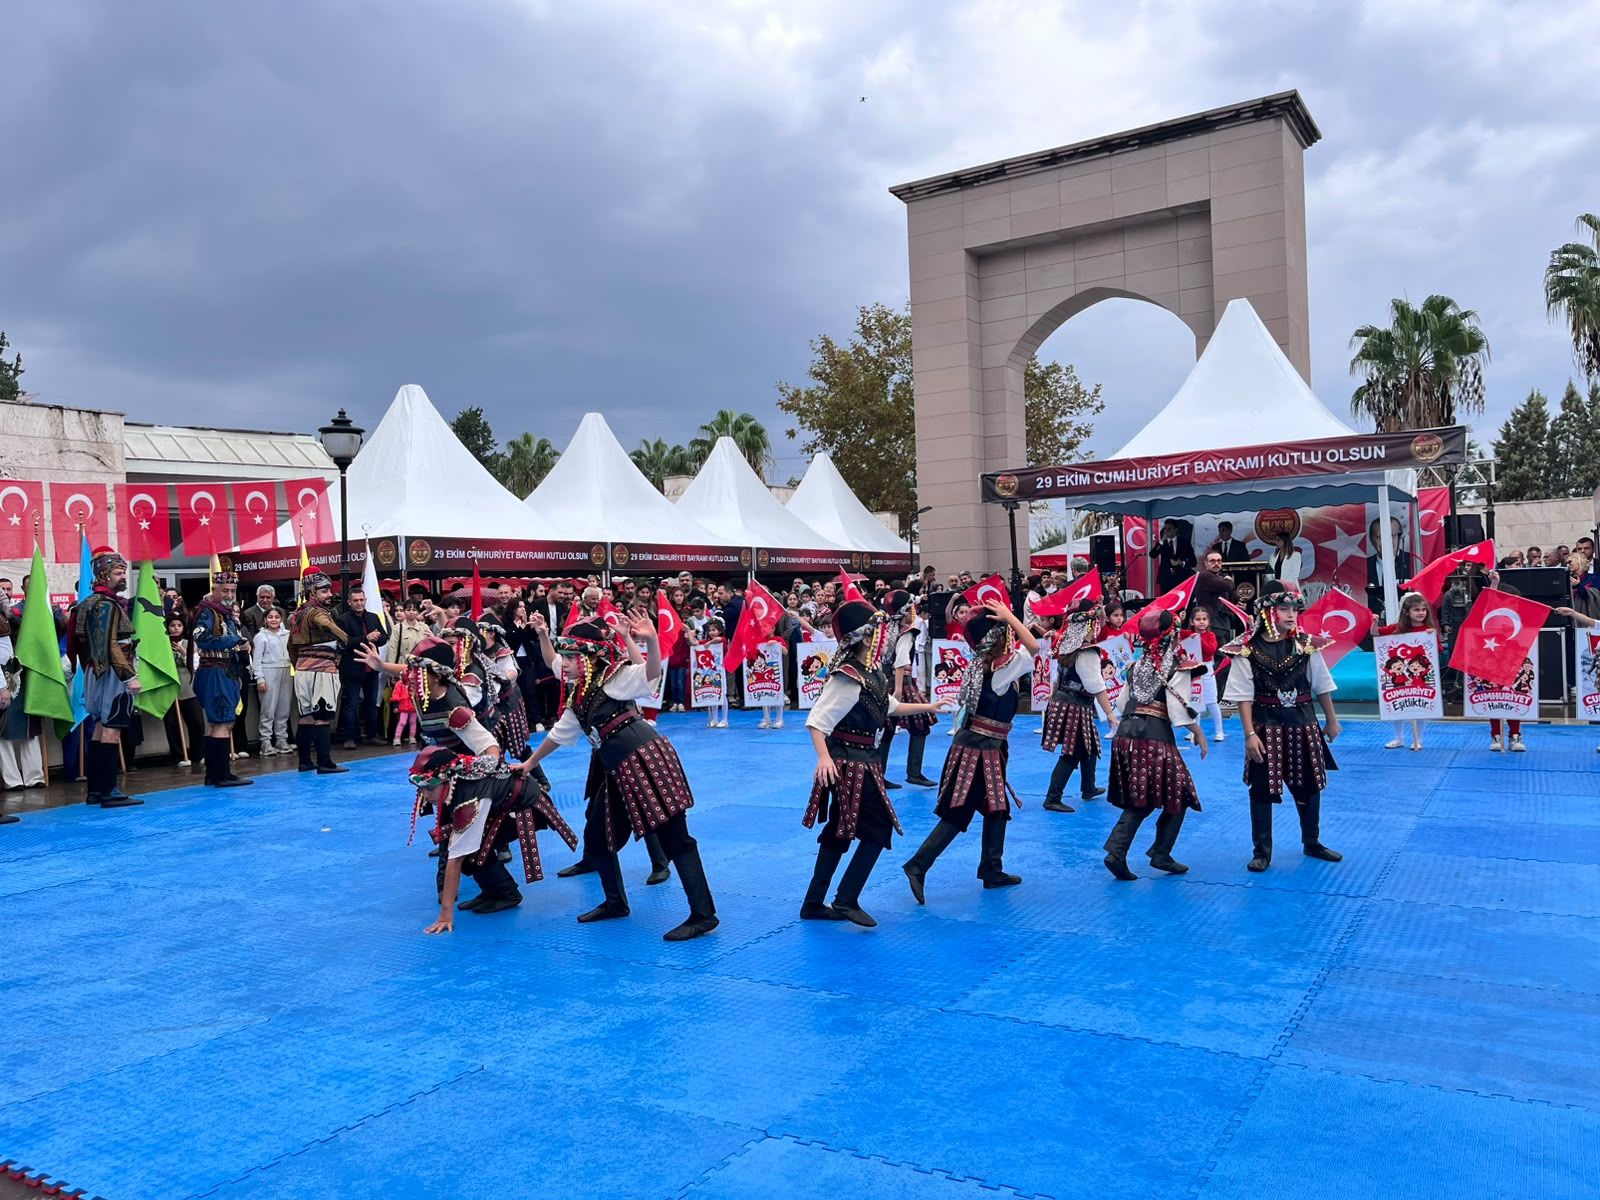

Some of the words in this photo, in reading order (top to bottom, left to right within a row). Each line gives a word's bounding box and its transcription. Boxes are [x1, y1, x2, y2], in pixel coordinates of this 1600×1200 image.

[1035, 476, 1052, 489] 29
[1056, 471, 1090, 487] EKİM
[1094, 463, 1189, 484] CUMHURİYET
[1194, 455, 1264, 474] BAYRAMI
[1268, 450, 1322, 467] KUTLU
[1326, 445, 1386, 463] OLSUN
[434, 549, 444, 559] 29
[446, 548, 465, 559] EKİM
[516, 550, 545, 560] BAYRAMI
[546, 551, 567, 560] KUTLU
[567, 551, 588, 560] OLSUN
[234, 562, 242, 572] 29
[243, 561, 257, 571] EKİM
[258, 558, 298, 570] CUMHURİYET
[1385, 685, 1434, 700] CUMHURİYET
[1472, 691, 1531, 705] CUMHURİYET
